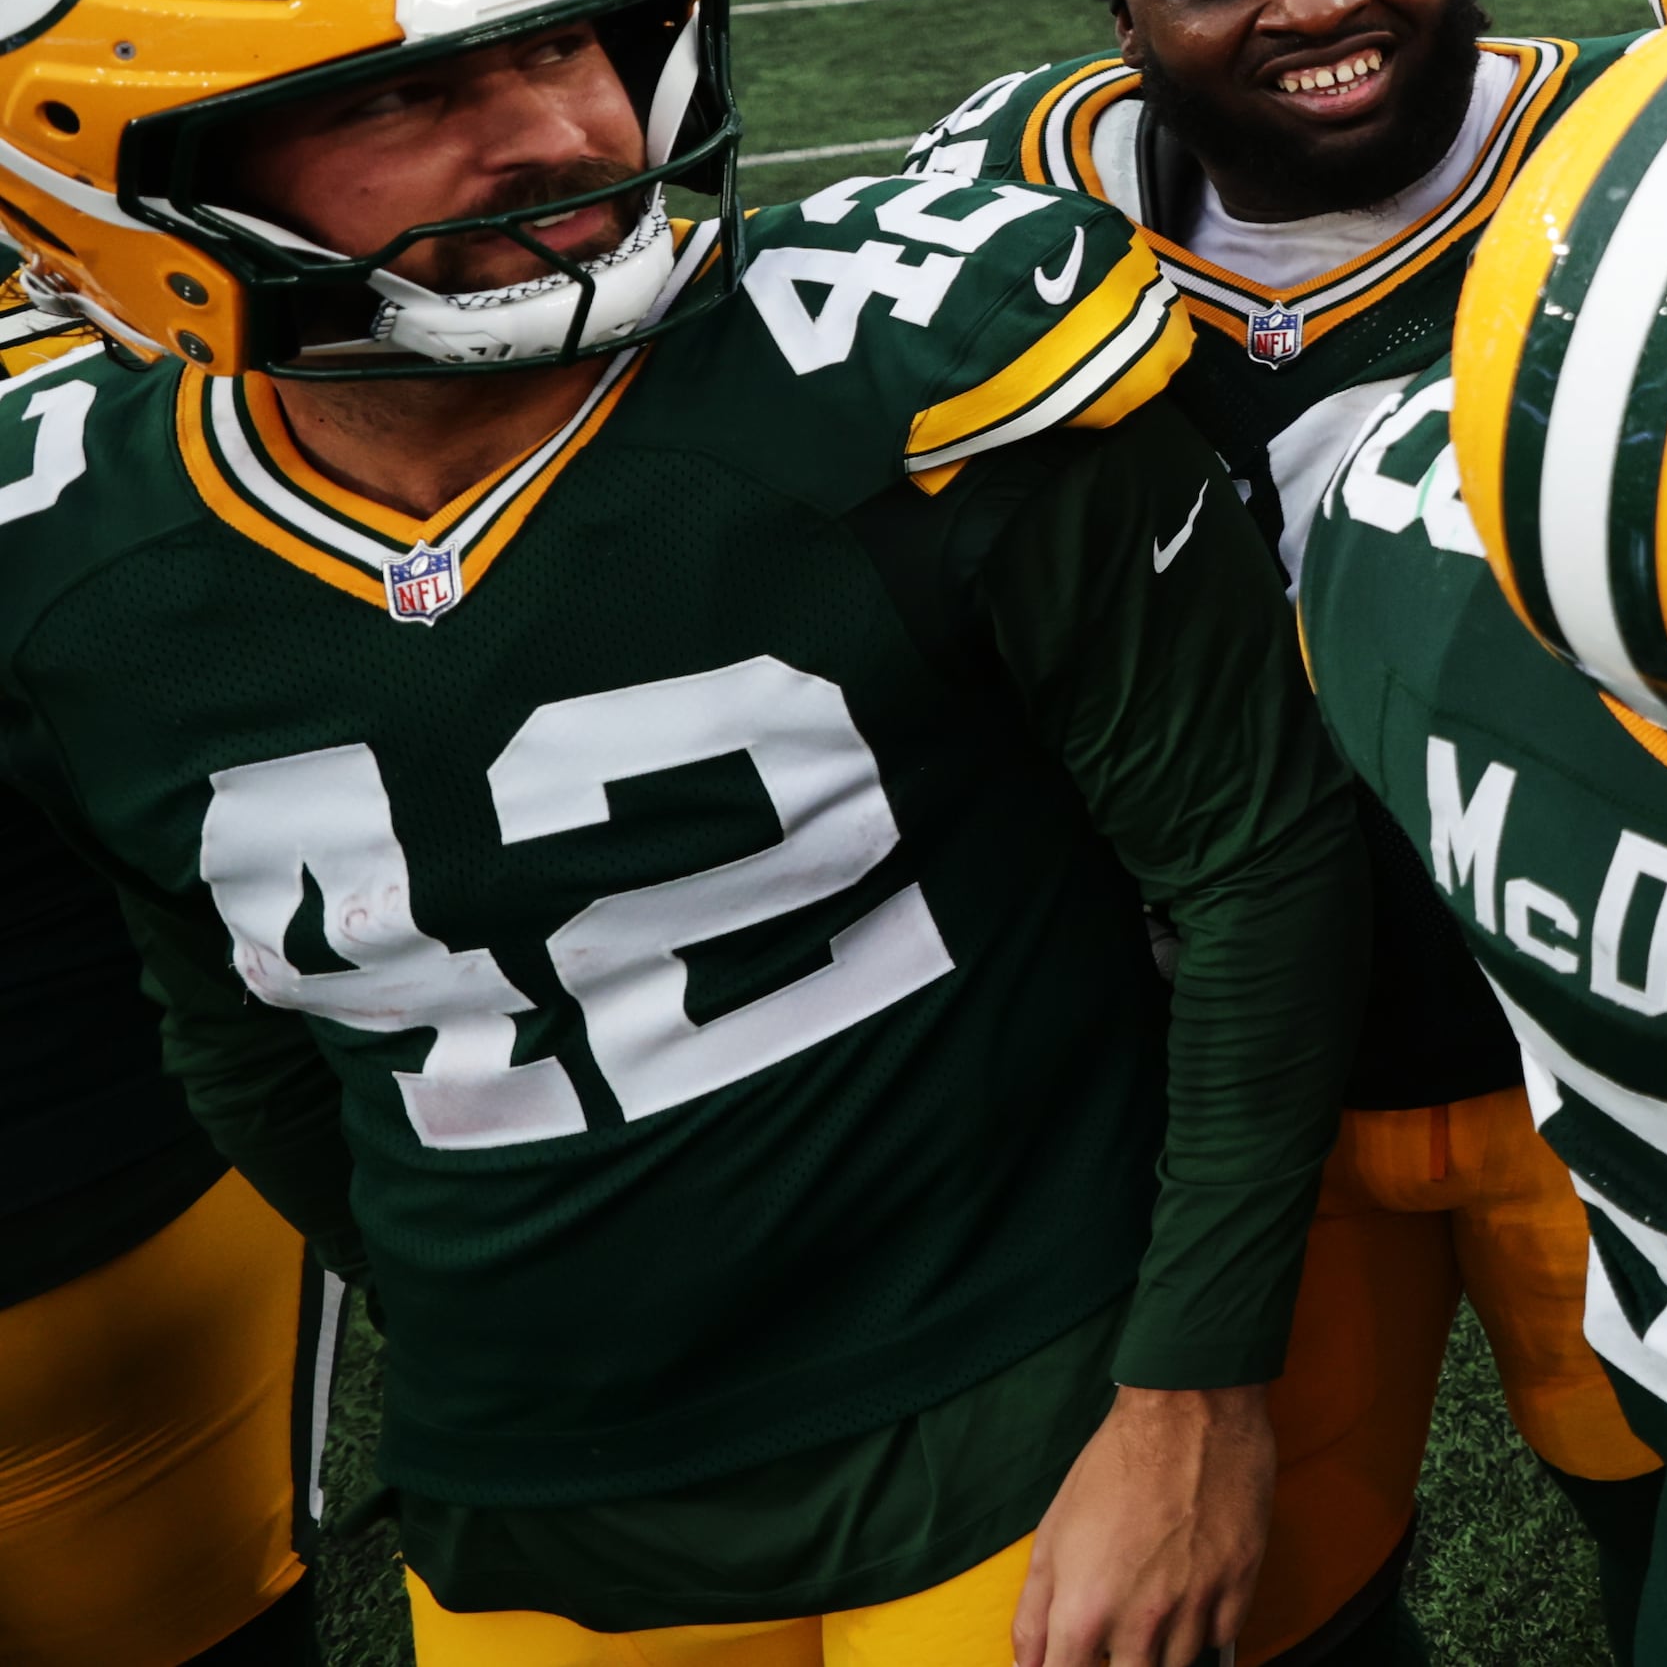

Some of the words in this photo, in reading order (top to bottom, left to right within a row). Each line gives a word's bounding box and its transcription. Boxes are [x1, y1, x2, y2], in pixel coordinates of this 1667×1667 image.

[743, 171, 1062, 375] 42
[1255, 331, 1292, 358] NFL
[396, 575, 449, 612] NFL
[200, 653, 956, 1151] 42
